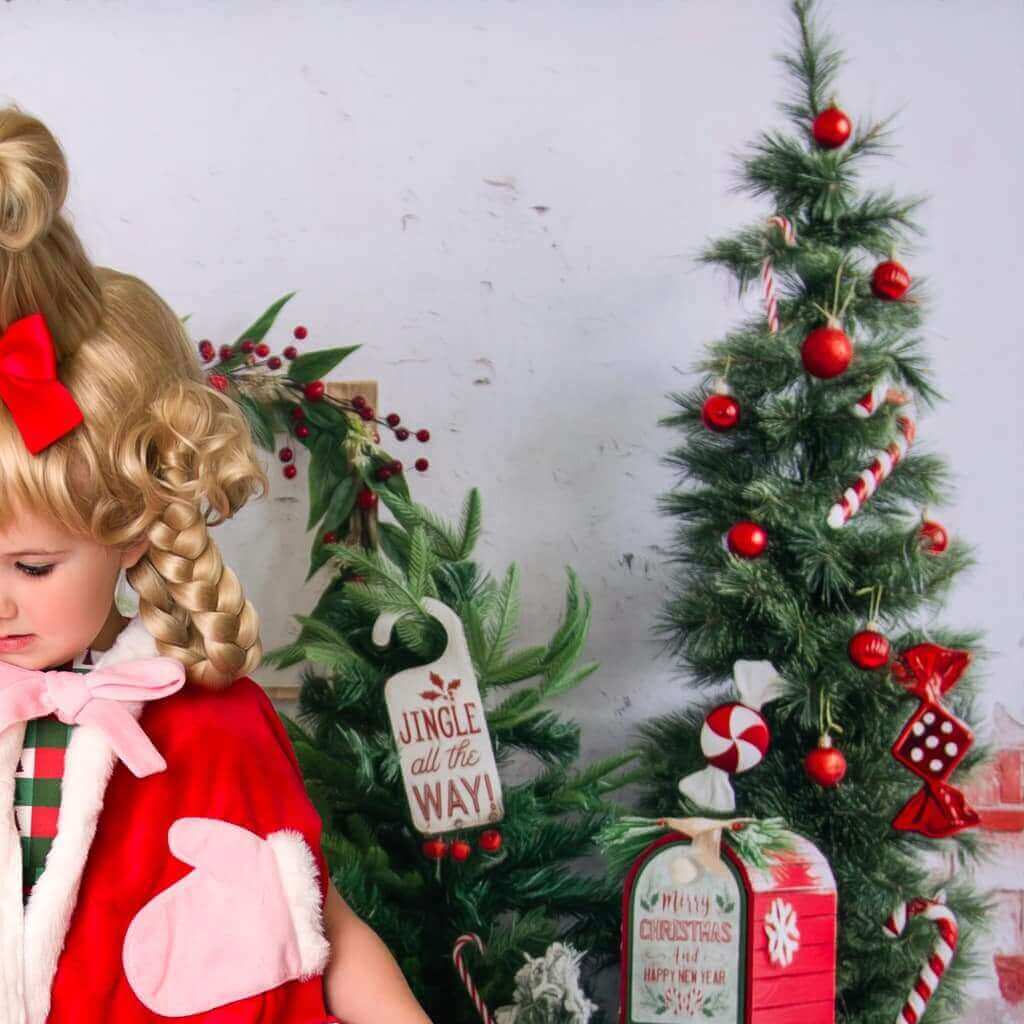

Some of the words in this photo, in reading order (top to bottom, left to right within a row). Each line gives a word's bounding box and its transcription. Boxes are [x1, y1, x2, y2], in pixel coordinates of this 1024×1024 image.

[399, 701, 481, 745] JINGLE
[411, 746, 441, 776] all
[446, 739, 480, 769] the
[412, 773, 497, 822] WAY!
[639, 918, 733, 943] CHRISTMAS
[644, 967, 675, 984] HAPPY
[678, 967, 697, 984] NEW
[701, 967, 726, 985] YEAR
